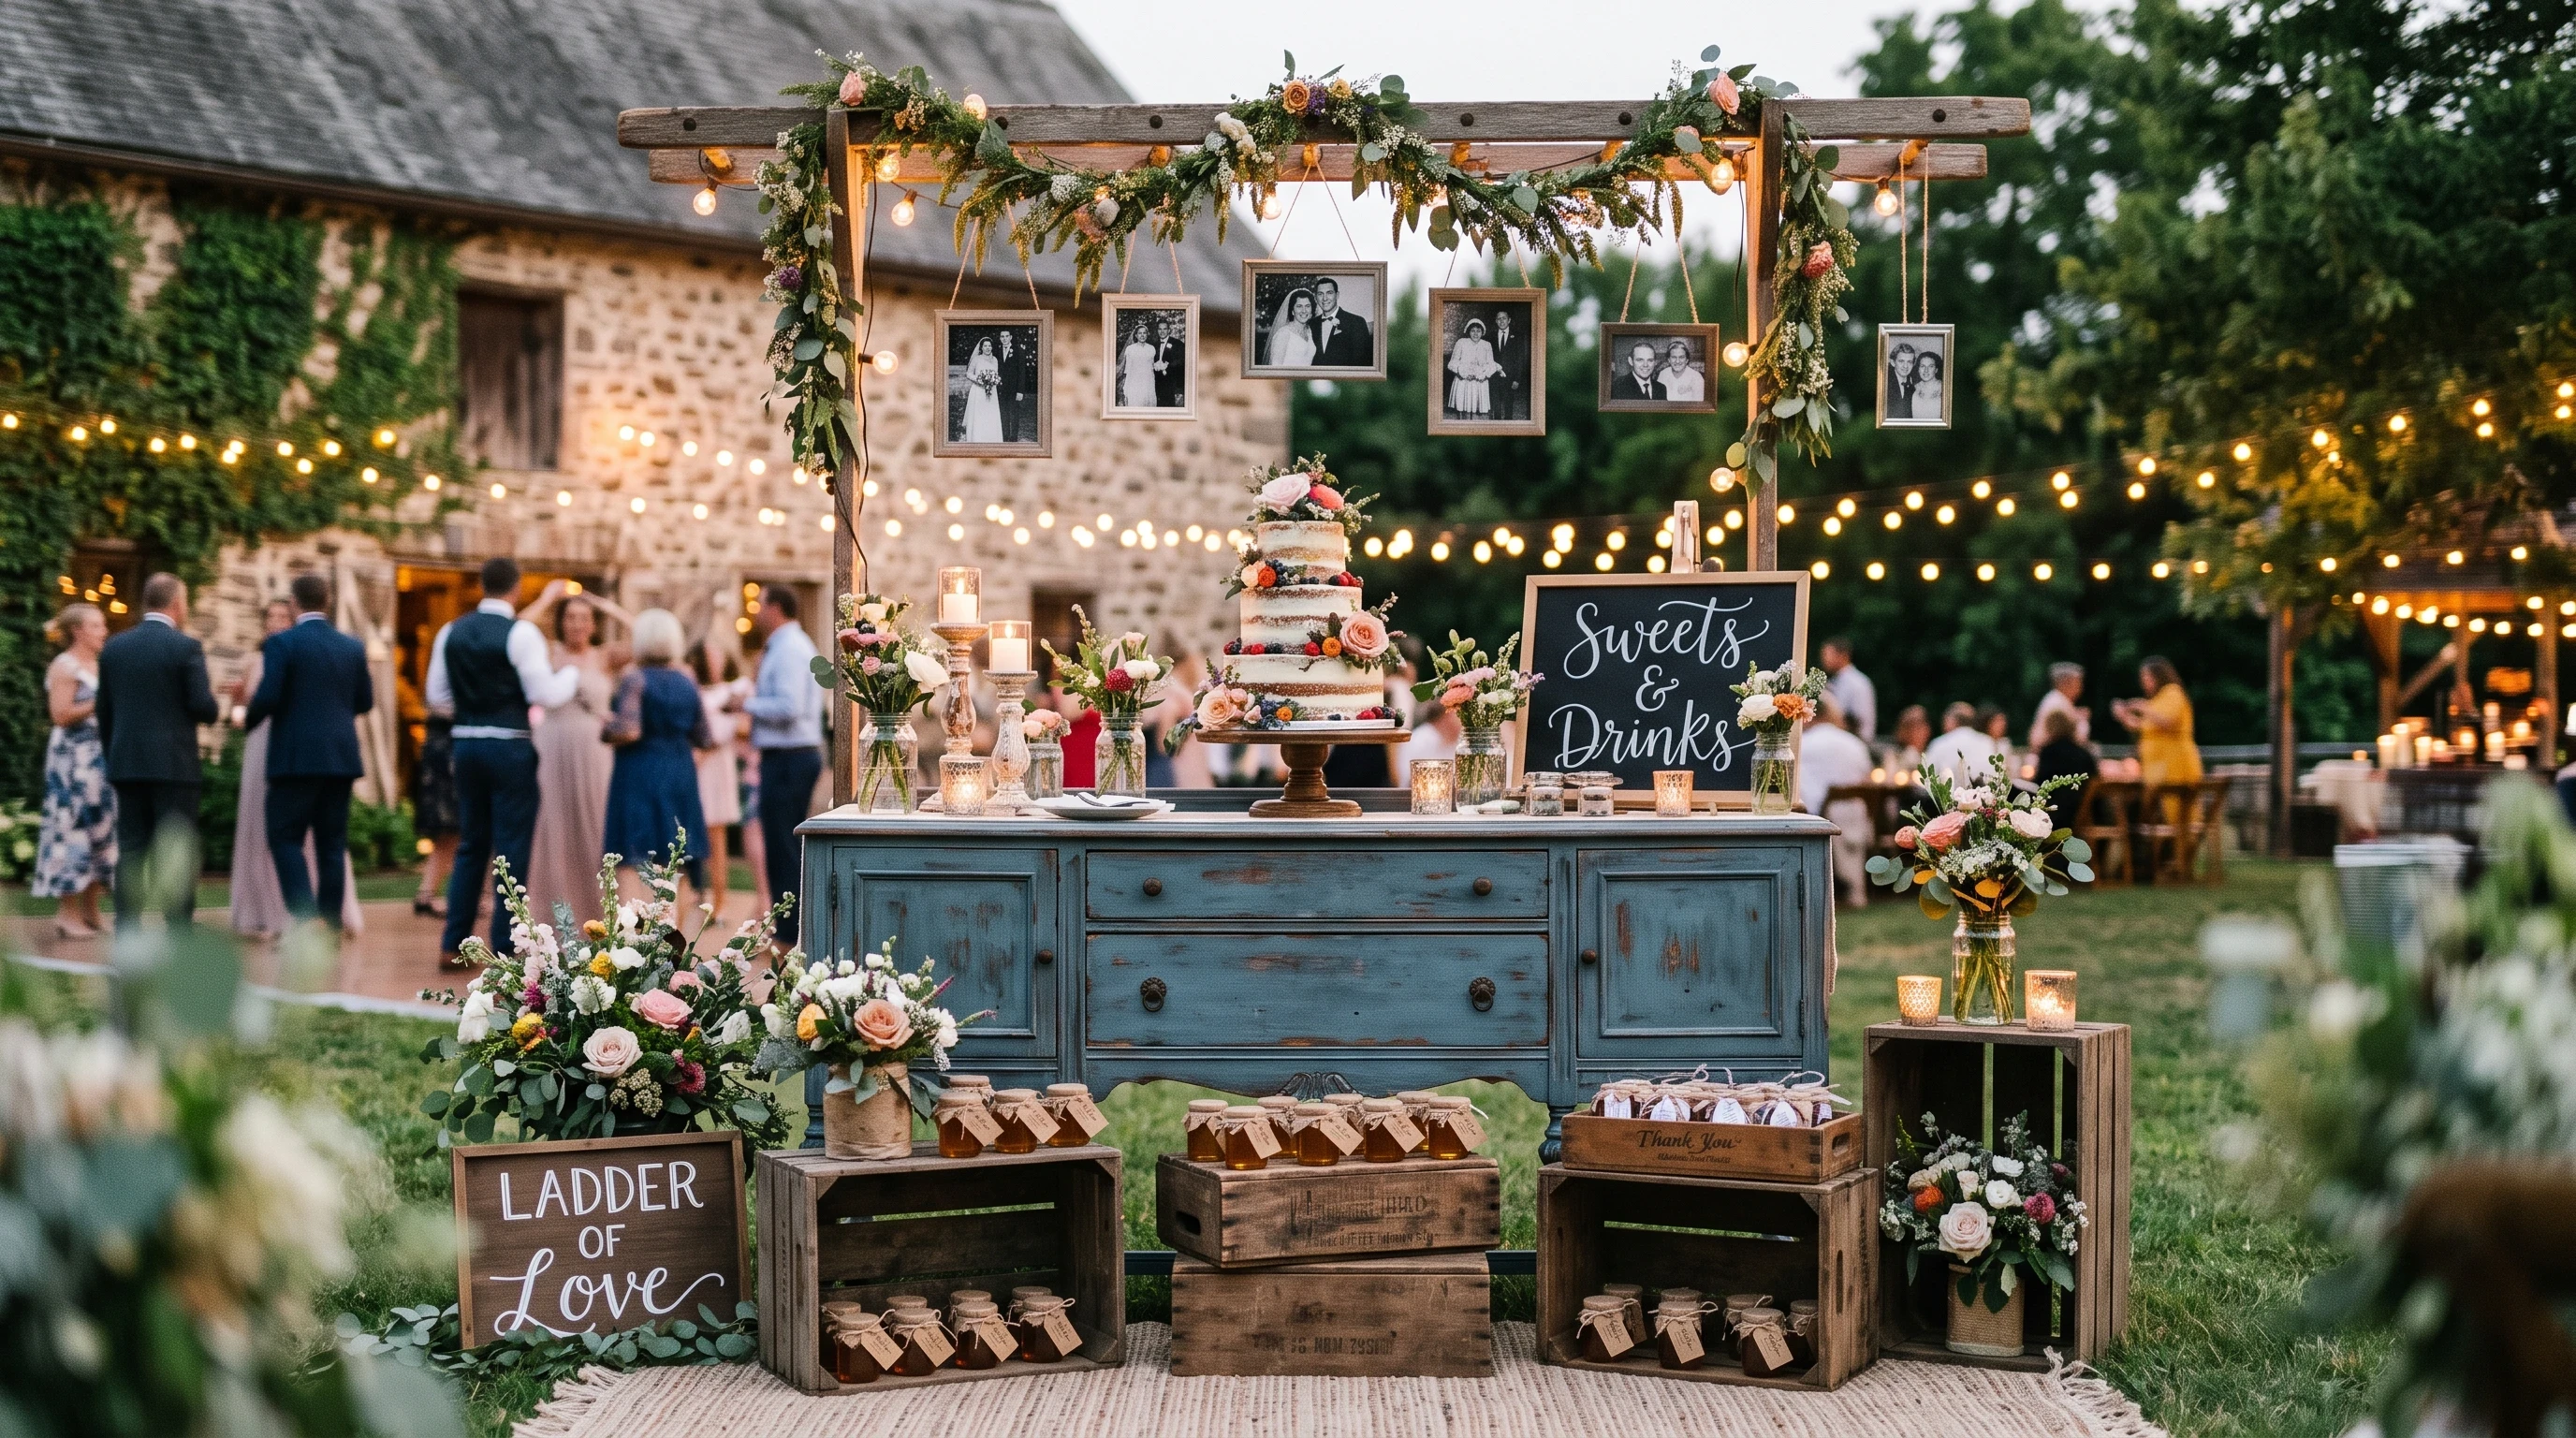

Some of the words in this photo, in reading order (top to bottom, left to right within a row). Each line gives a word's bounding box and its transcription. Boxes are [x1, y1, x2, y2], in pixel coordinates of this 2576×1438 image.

[1563, 596, 1769, 680] Sweets
[1635, 664, 1680, 712] &
[1548, 699, 1756, 772] Drinks
[1636, 1129, 1694, 1149] Thank
[1688, 1132, 1738, 1154] You
[500, 1160, 704, 1221] LADDER
[578, 1223, 626, 1259] OF
[489, 1247, 724, 1339] Love
